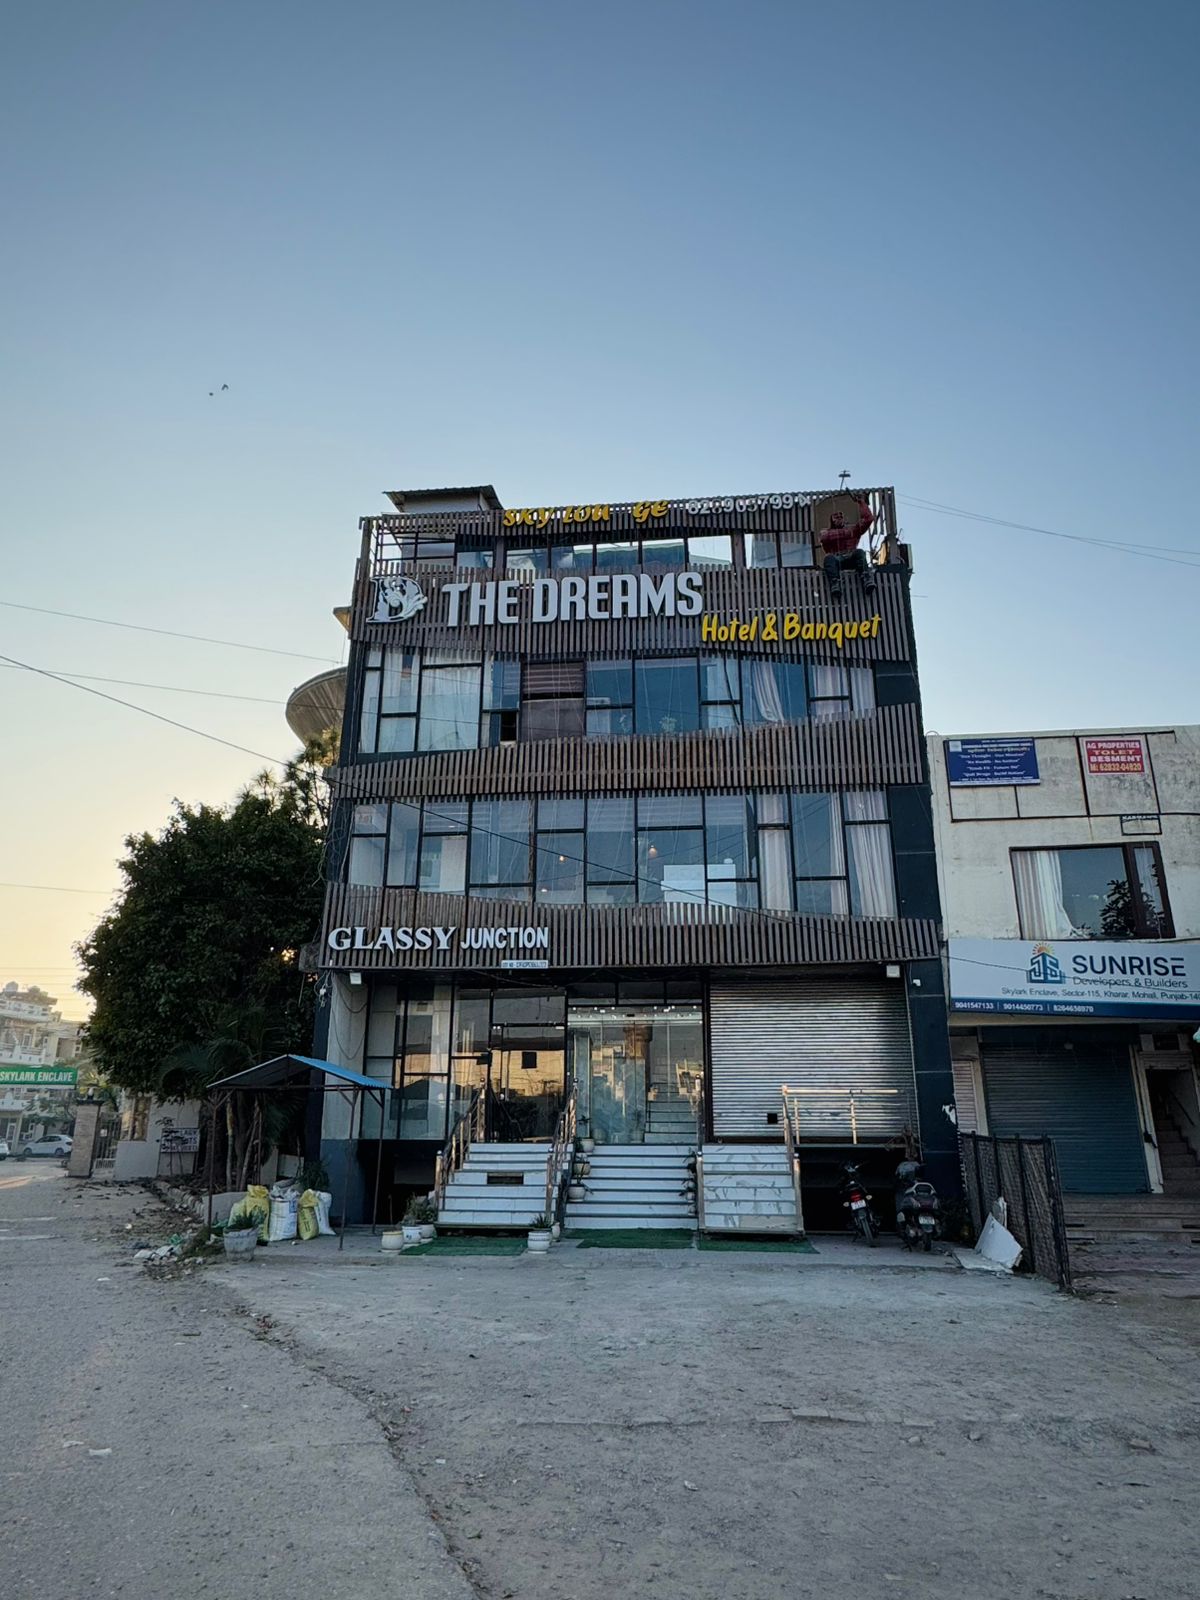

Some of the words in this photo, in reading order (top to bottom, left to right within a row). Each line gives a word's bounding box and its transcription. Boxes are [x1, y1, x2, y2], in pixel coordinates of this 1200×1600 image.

[441, 580, 522, 627] THE
[532, 572, 703, 623] DREAMS
[702, 614, 758, 642] Hotel
[761, 613, 778, 641] &
[783, 613, 882, 649] Banquet
[1097, 741, 1140, 749] PROPERTIES
[1089, 755, 1142, 763] BESMENT
[328, 926, 457, 954] GLASSY
[460, 926, 549, 949] JUNCTION
[1072, 954, 1187, 977] SUNRISE
[1073, 976, 1131, 989] Developers
[1134, 977, 1142, 987] &
[1144, 977, 1188, 989] Builders
[1001, 987, 1027, 997] Skylark
[0, 1071, 36, 1082] SKYLARK
[37, 1071, 73, 1082] ENCLAVE
